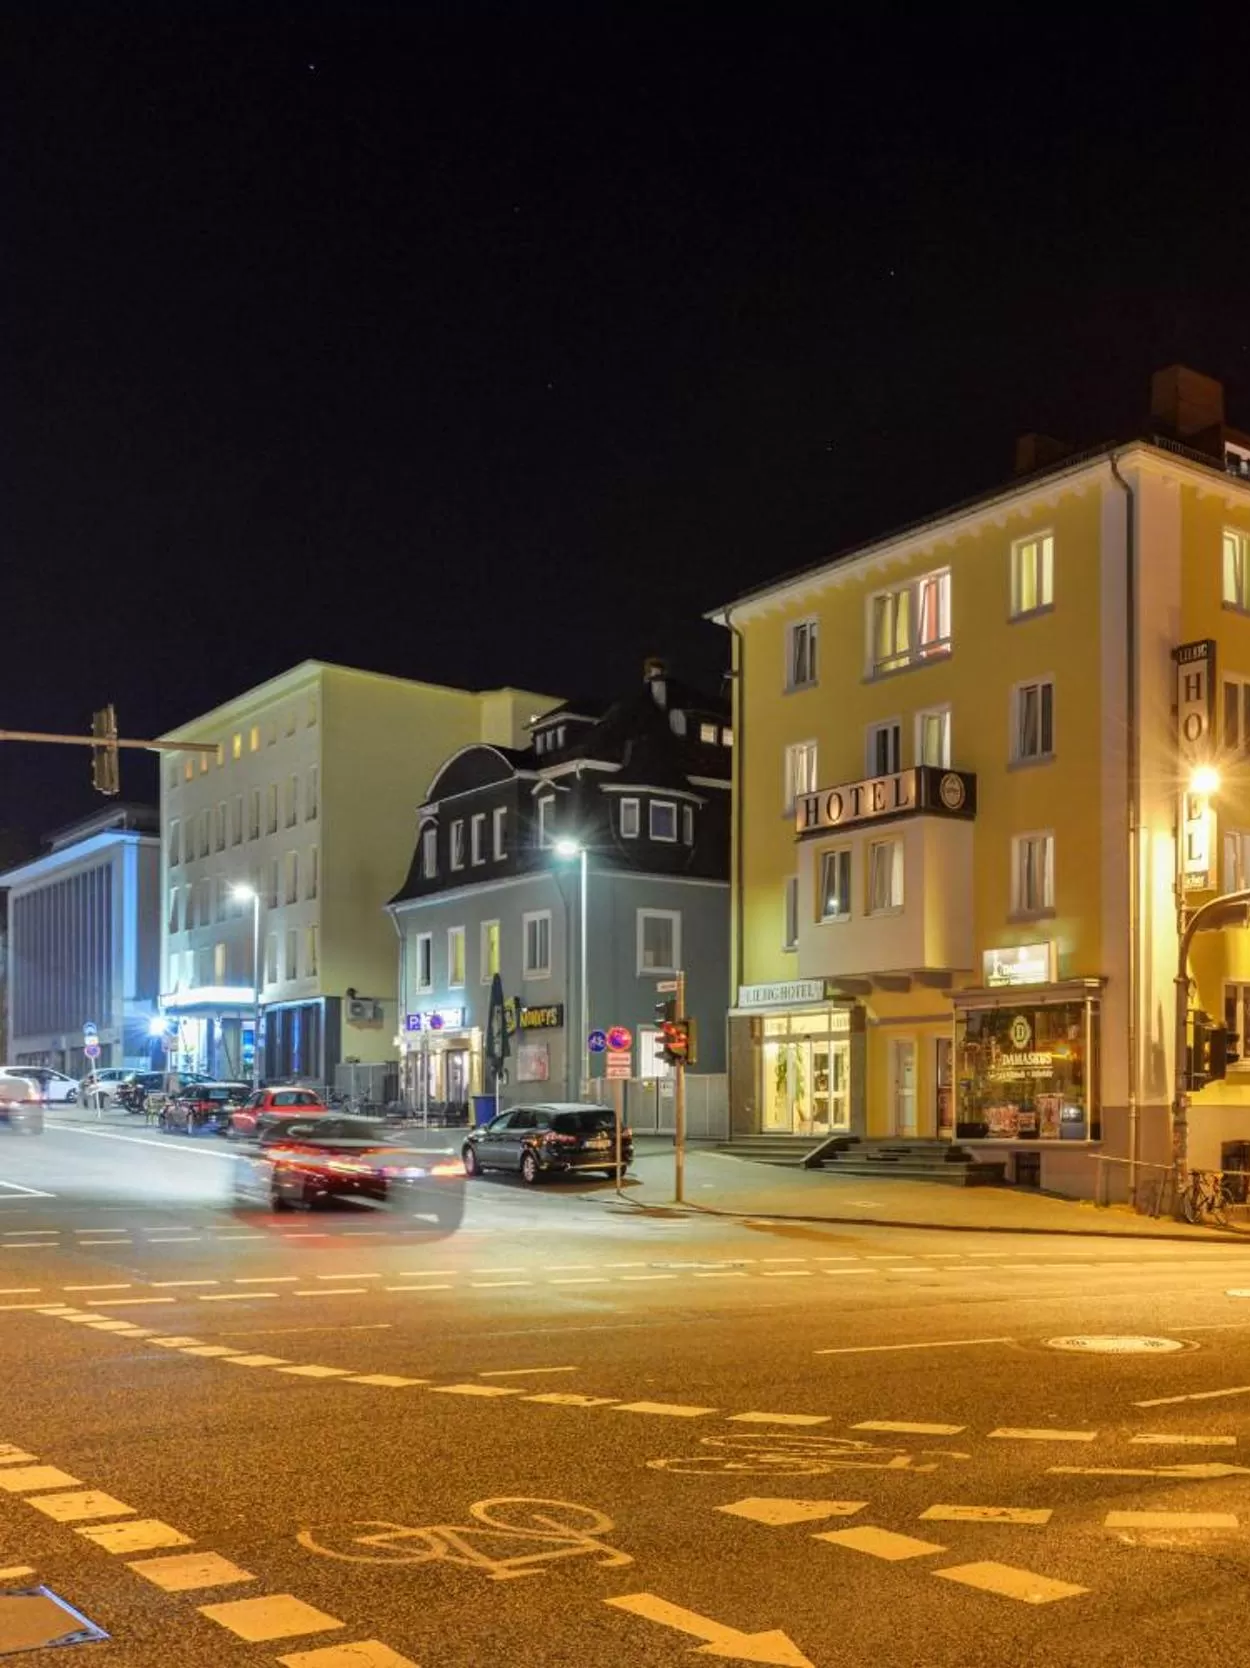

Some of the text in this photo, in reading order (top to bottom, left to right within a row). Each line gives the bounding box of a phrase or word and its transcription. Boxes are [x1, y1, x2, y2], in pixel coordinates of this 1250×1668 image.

[1184, 671, 1203, 861] HOEL
[804, 778, 910, 827] HOTEL
[1002, 1052, 1052, 1066] DAMASKUS
